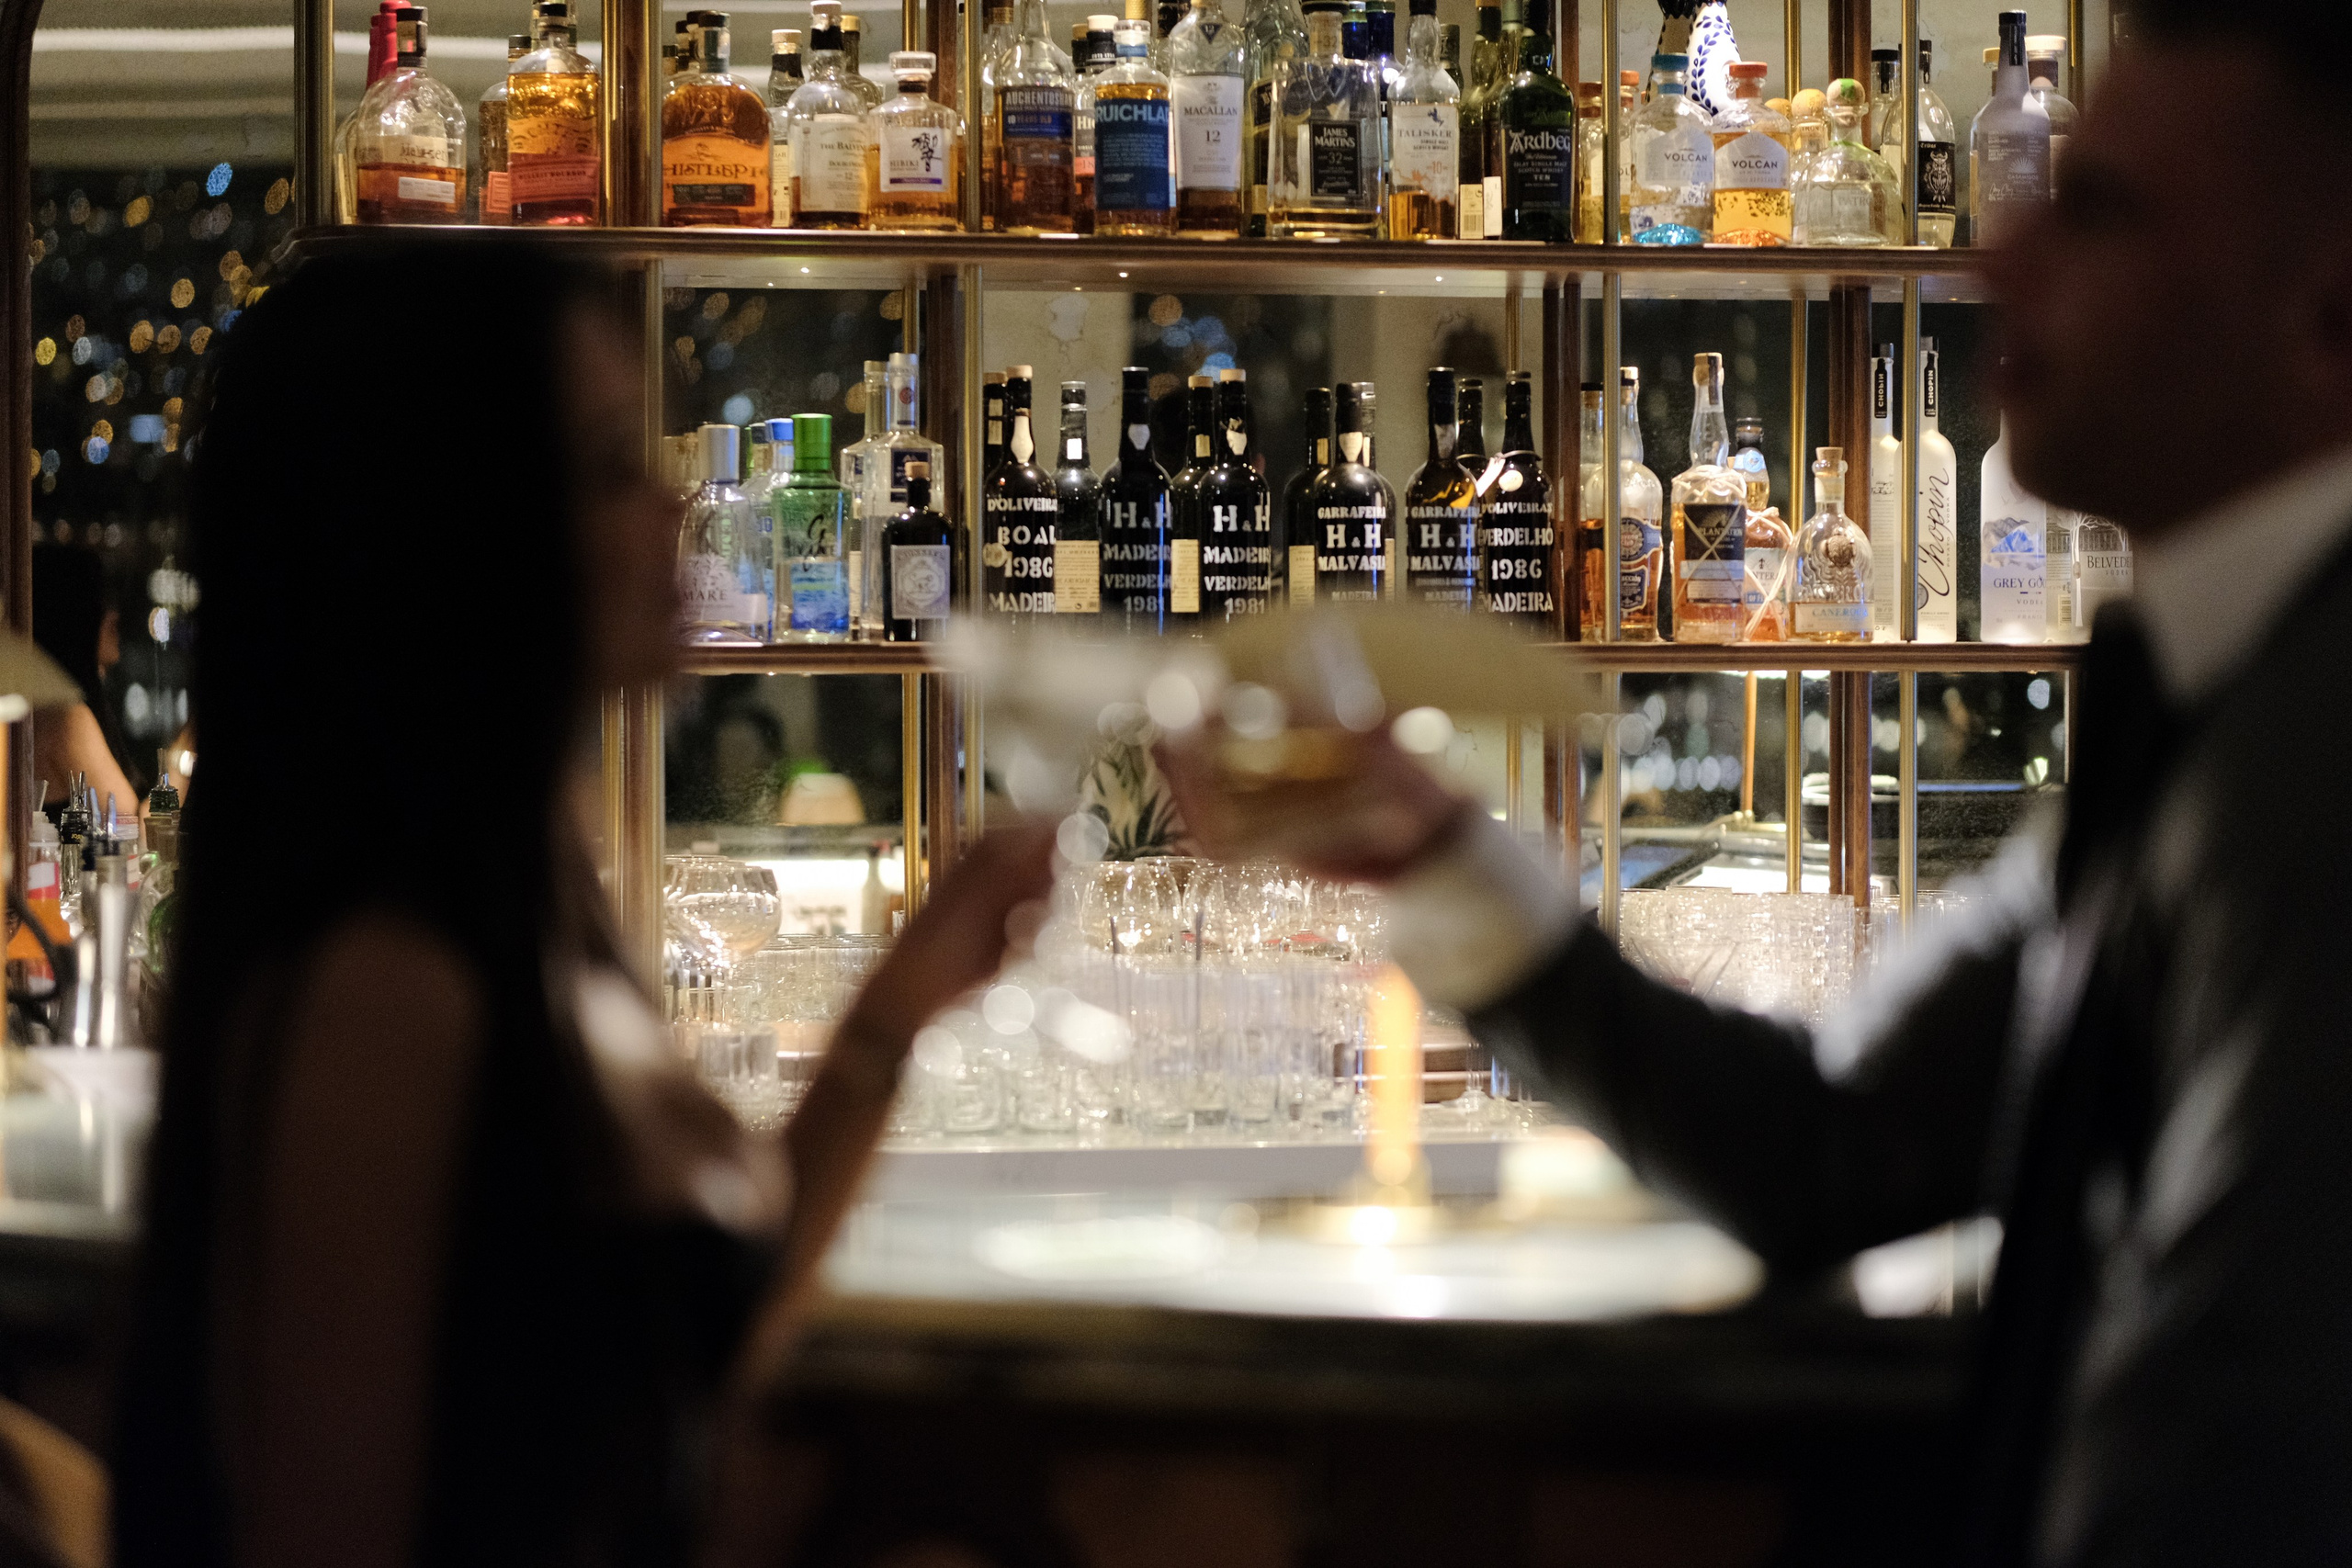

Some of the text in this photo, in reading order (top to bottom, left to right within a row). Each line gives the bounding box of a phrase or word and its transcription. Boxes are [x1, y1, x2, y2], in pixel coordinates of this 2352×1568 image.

[1184, 107, 1238, 116] MACALLAN
[1205, 130, 1221, 142] 12
[1324, 127, 1347, 136] JAMES
[1399, 130, 1452, 138] TALISKER
[1665, 153, 1707, 162] VOLCAN
[1732, 161, 1778, 169] VOLCAN
[1114, 502, 1137, 529] H
[1213, 505, 1270, 533] H & H
[1327, 524, 1382, 548] H & H
[1420, 524, 1476, 548] H & H
[1994, 579, 2025, 588] GREY
[1224, 597, 1264, 615] 1981
